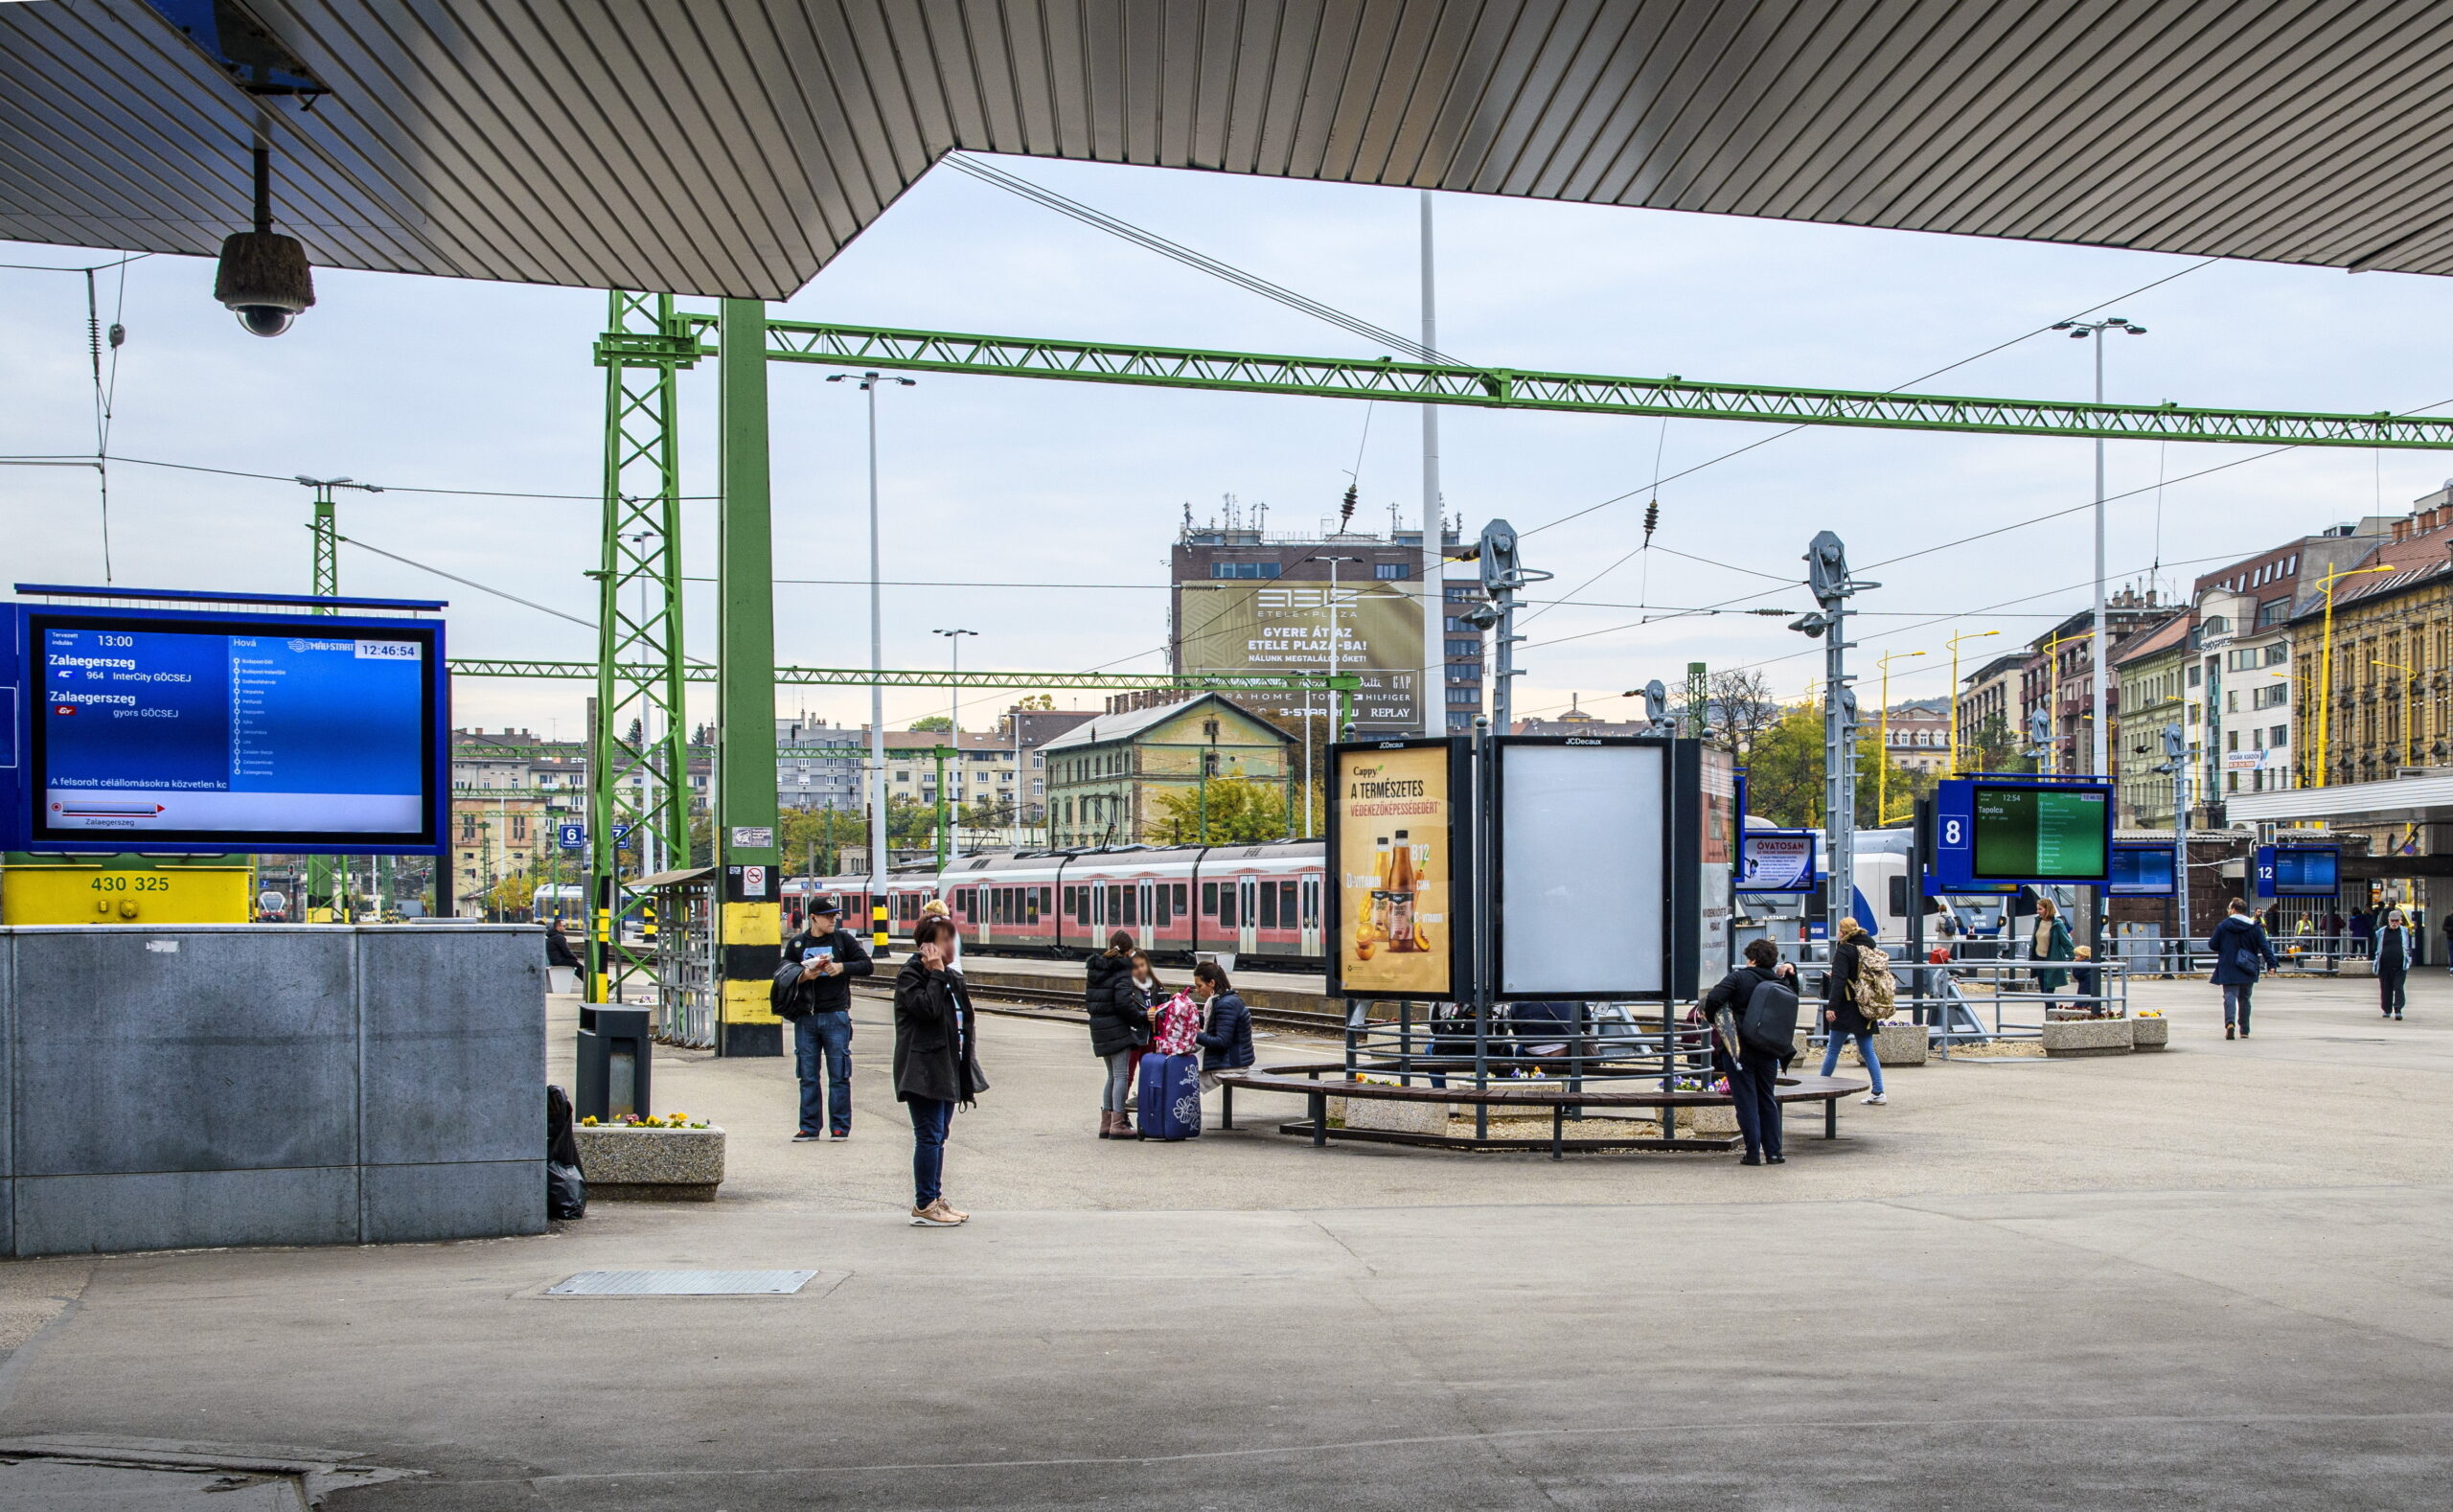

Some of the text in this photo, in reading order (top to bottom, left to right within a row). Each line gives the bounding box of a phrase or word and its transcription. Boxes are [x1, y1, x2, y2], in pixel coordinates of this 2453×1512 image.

[1263, 627, 1307, 638] GYERE
[1312, 625, 1330, 638] ÁT
[97, 635, 133, 647] 13:00
[1248, 640, 1289, 650] ETELE
[233, 638, 257, 648] Hová
[362, 644, 415, 657] 12:46:54
[49, 654, 136, 670] Zalaegerszeg
[1249, 653, 1283, 662] NÁLUNK
[1342, 653, 1367, 662] ŐKET!
[86, 671, 104, 680] 964
[113, 672, 152, 683] InterCity
[1392, 675, 1411, 689] GAP
[49, 690, 136, 706] Zalaegerszeg
[113, 709, 139, 718] gyors
[1371, 708, 1410, 717] REPLAY
[1565, 737, 1602, 745] JCDecaux
[1353, 766, 1378, 779] Cappy
[51, 778, 58, 786] A
[60, 778, 98, 787] felsorolt
[101, 779, 170, 788] célállomásokra
[172, 779, 215, 788] közvetlen
[1351, 778, 1424, 800] A TERMÉSZETES
[1978, 806, 2004, 815] Tapolca
[85, 818, 135, 827] Zalaegerszeg
[566, 828, 577, 841] 6
[613, 829, 621, 838] 7
[1946, 820, 1961, 844] 8
[1757, 840, 1804, 850] ÓVATOSAN
[2258, 866, 2273, 879] 12
[91, 877, 169, 891] 430 325
[1346, 873, 1381, 889] D-VITAMIN
